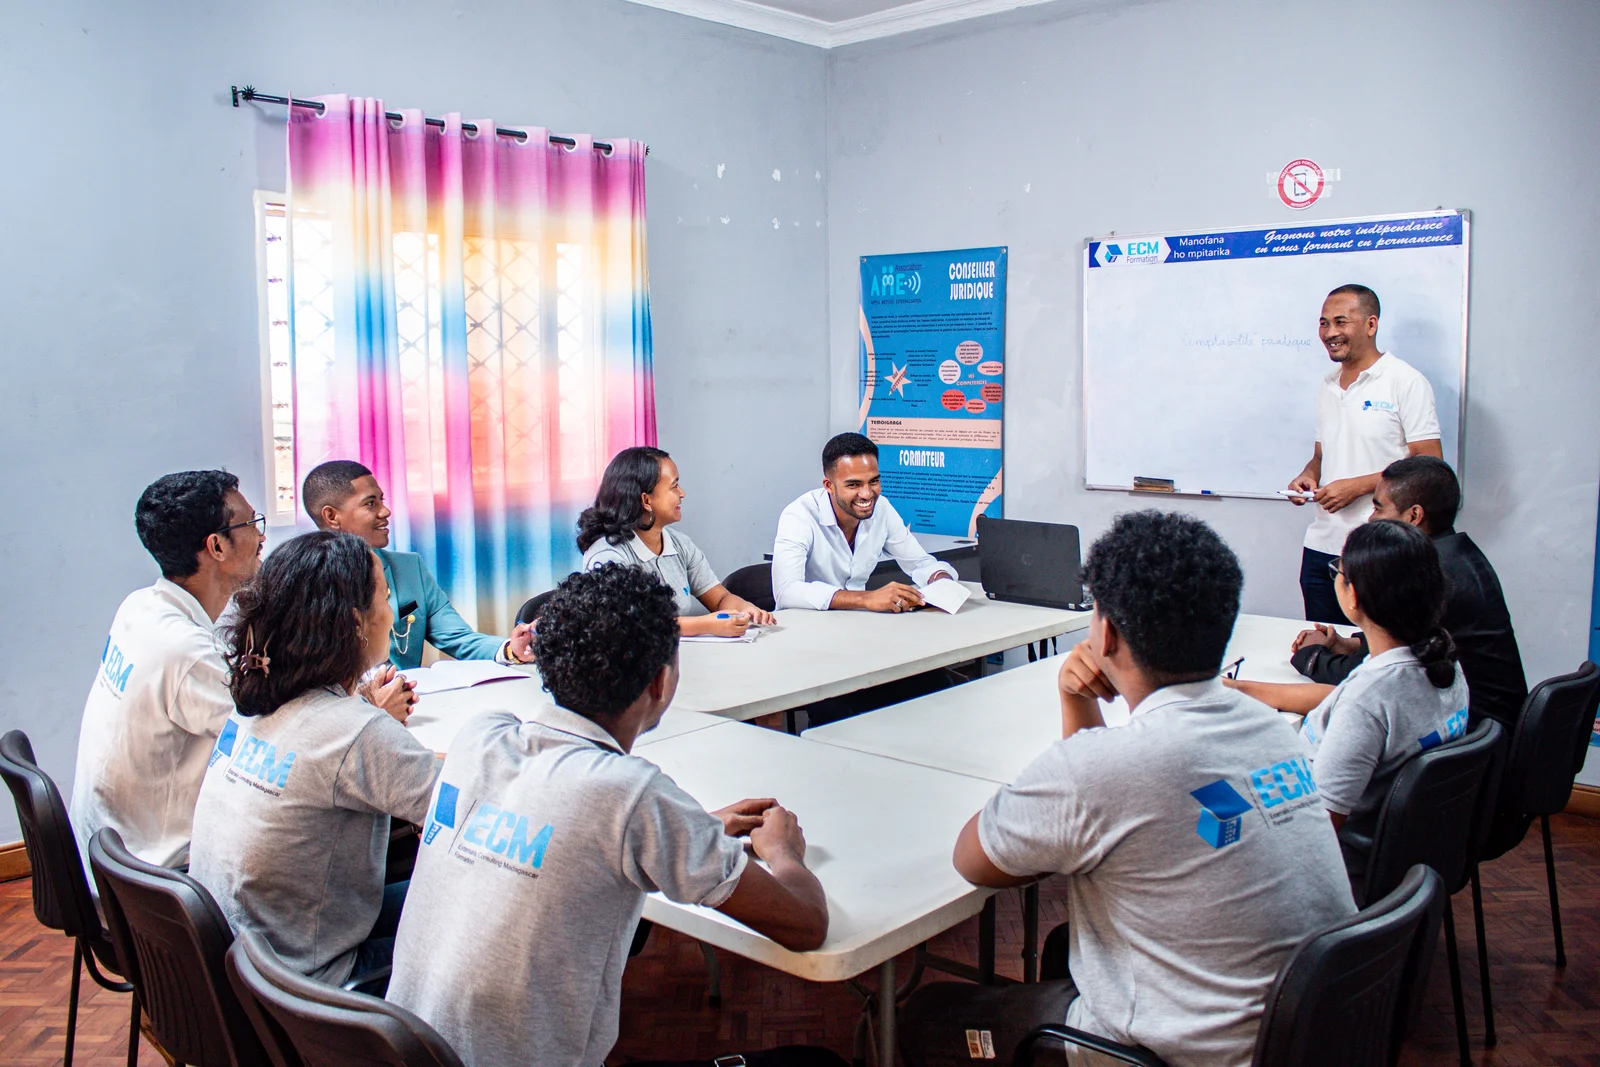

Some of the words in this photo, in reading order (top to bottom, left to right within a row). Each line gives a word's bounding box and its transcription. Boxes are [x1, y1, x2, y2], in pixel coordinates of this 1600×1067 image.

[1179, 236, 1225, 246] Manofana
[1254, 246, 1268, 254] en
[1272, 244, 1299, 253] nous
[1302, 239, 1354, 254] formant
[1357, 239, 1372, 247] en
[1374, 233, 1454, 249] permanence
[1264, 230, 1315, 245] Gagnons
[1320, 228, 1351, 238] notre
[1355, 221, 1444, 236] indépendance
[1127, 241, 1159, 256] ECM
[1173, 250, 1185, 259] ho
[1187, 247, 1230, 260] mpitarika
[949, 261, 995, 280] CONSEILLER
[949, 281, 994, 300] JURIDIQUE
[899, 449, 945, 468] FORMATEUR
[105, 644, 134, 692] ECM
[1447, 706, 1468, 739] EC
[233, 735, 297, 788] ECM
[1250, 756, 1318, 809] ECM
[463, 802, 555, 869] ECM
[477, 851, 503, 868] Consulting
[503, 861, 539, 880] Madagascar
